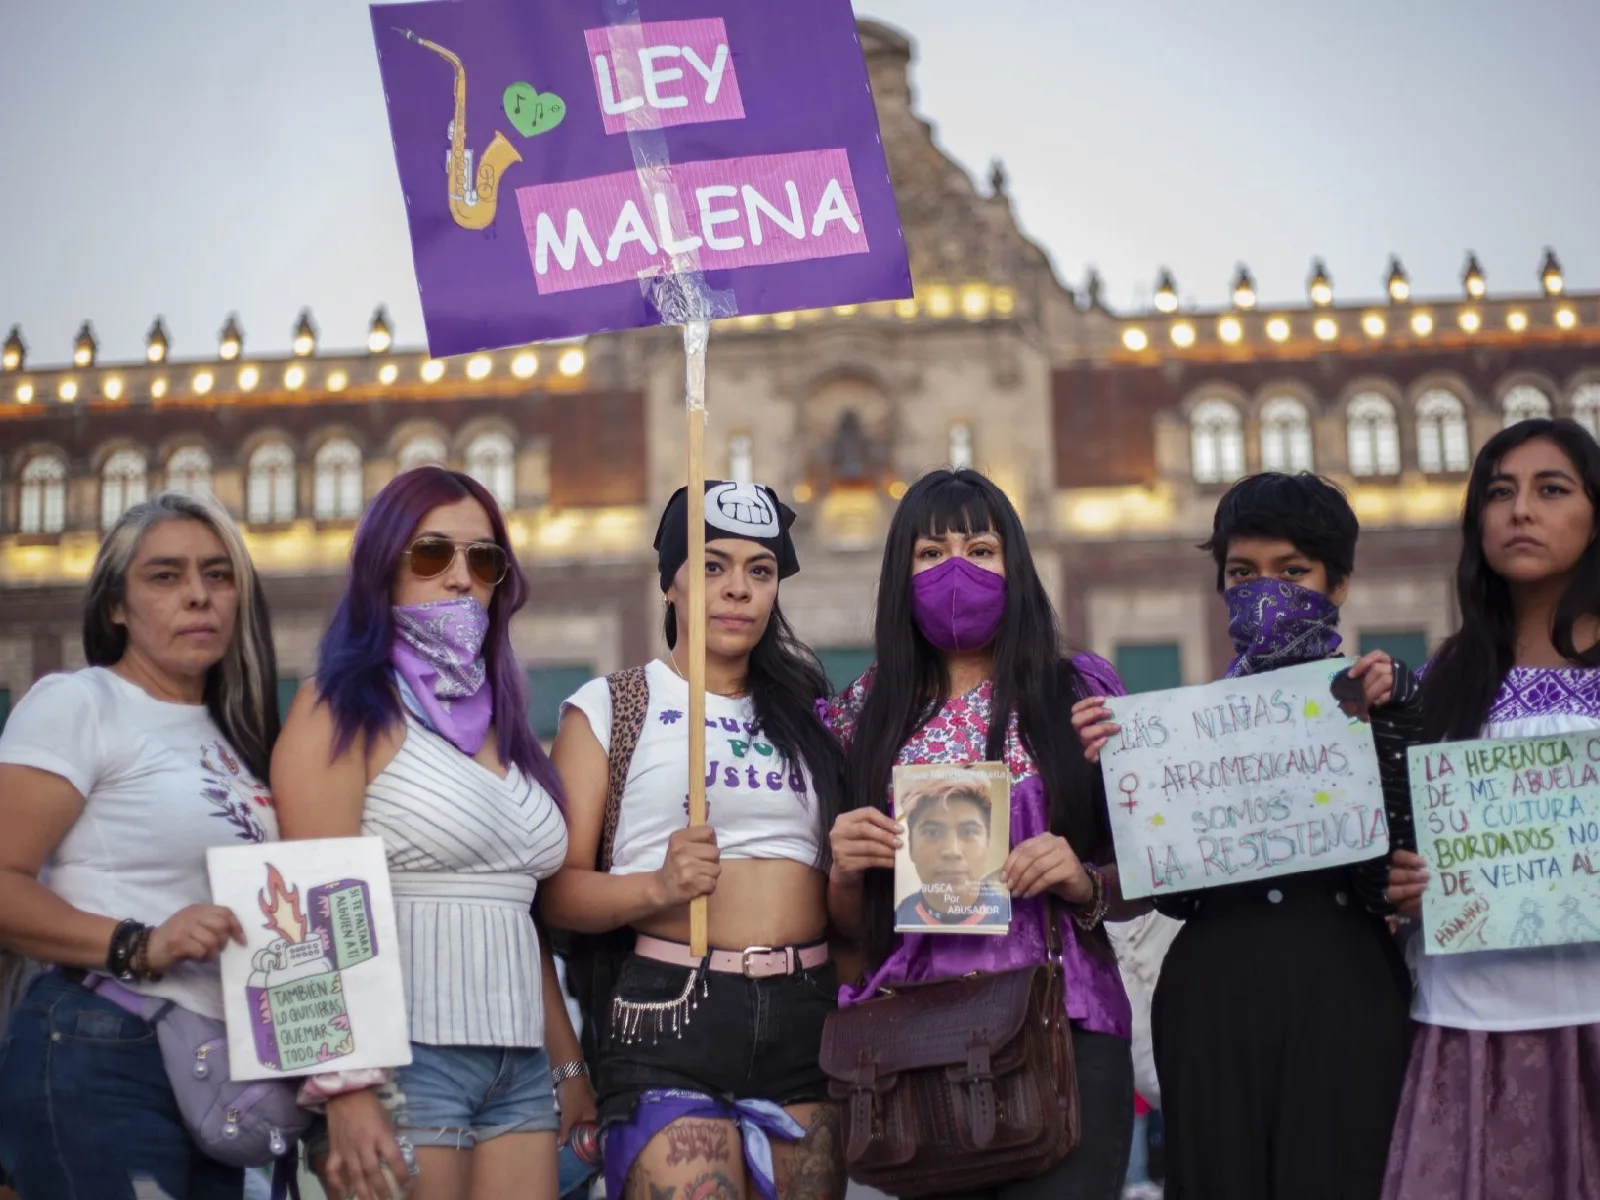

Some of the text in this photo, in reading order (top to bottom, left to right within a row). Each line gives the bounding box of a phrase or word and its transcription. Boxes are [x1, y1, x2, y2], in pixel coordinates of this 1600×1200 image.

[595, 44, 729, 116] LEY
[534, 178, 860, 275] MALENA
[1192, 689, 1292, 741] NIÑAS
[1161, 743, 1348, 795] AFROMEXICANAS
[1424, 753, 1455, 782] LA
[1464, 739, 1574, 777] HERENCIA
[1427, 763, 1599, 809] DE MI ABUELA
[1191, 796, 1291, 833] SOMOS
[1428, 795, 1585, 834] SU CULTURA
[1147, 805, 1389, 888] LA RESISTENCIA
[1433, 821, 1599, 869] BORDADOS NO
[921, 883, 953, 893] BUSCA
[1440, 852, 1600, 897] DE VENTA AL
[944, 894, 960, 903] Por
[947, 905, 1000, 914] ABUSADOR
[336, 895, 361, 958] ALGUIEN A TI
[349, 888, 370, 955] SI TE FALTARA
[275, 1011, 287, 1026] LO
[280, 1024, 334, 1045] QUEMAR
[284, 1046, 314, 1064] TODO
